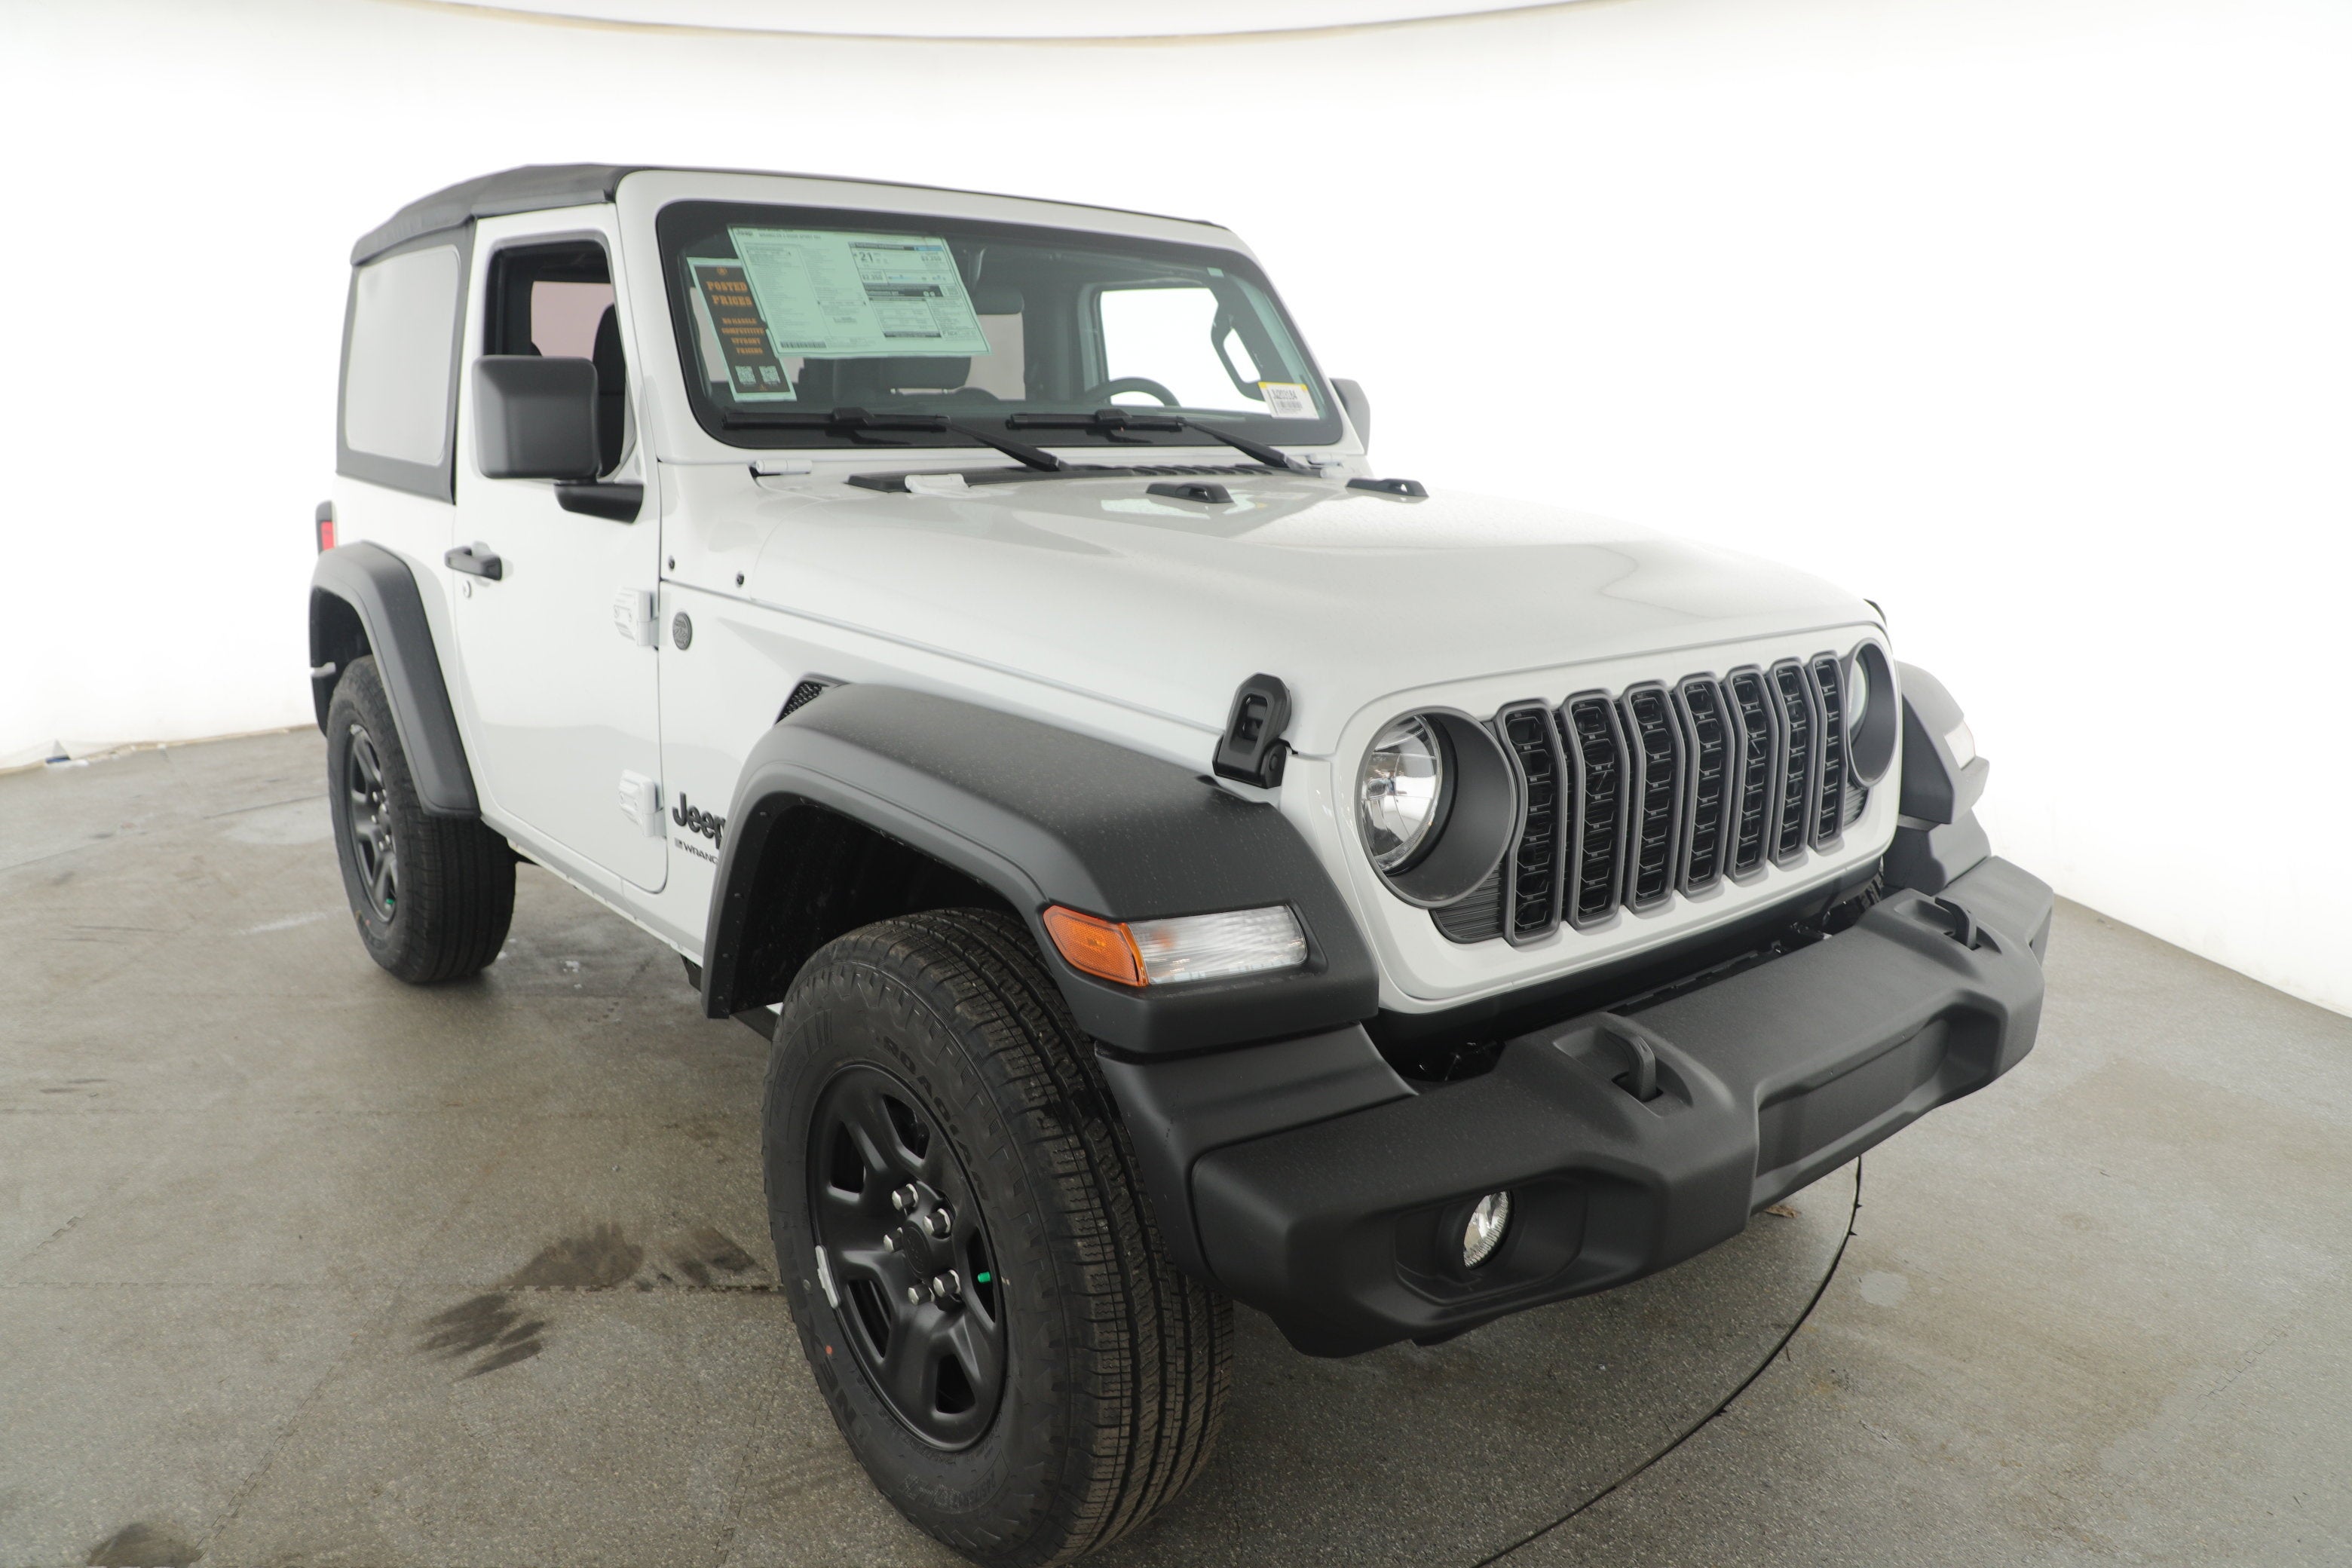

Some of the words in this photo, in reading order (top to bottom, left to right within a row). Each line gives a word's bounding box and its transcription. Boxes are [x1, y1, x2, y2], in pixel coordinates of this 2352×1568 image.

[706, 281, 748, 292] POSTED
[712, 295, 753, 306] PRICES
[672, 791, 726, 850] Jeep
